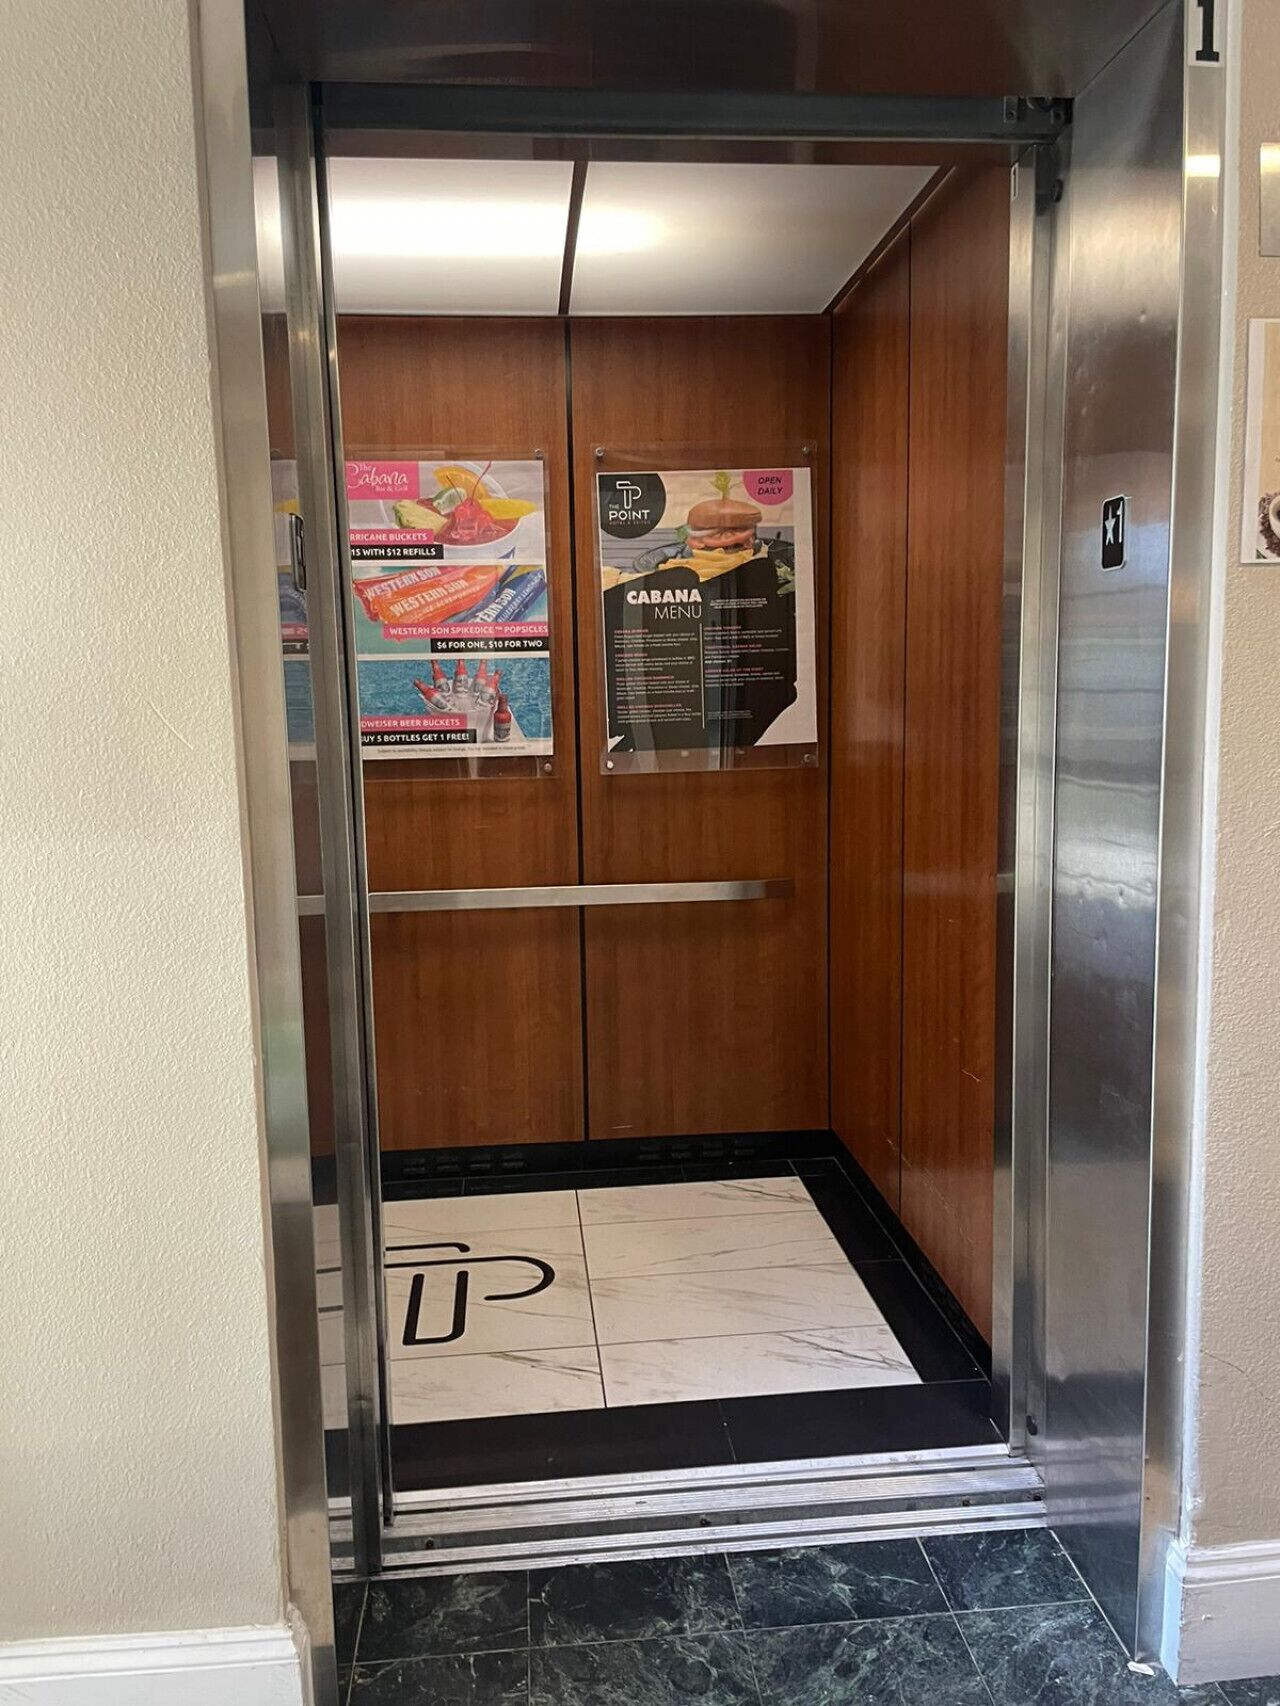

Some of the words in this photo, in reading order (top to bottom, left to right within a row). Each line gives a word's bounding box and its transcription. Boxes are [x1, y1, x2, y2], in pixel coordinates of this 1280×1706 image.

[1196, 0, 1219, 62] 1
[758, 476, 782, 485] OPEN
[757, 487, 783, 495] DAILY
[608, 509, 650, 521] POINT
[388, 532, 428, 541] BUCKETS
[362, 548, 385, 556] WITH
[386, 548, 402, 557] $12
[402, 547, 436, 556] REFILLS
[389, 586, 448, 616] WESTERN
[626, 588, 703, 605] CABANA
[654, 605, 702, 620] MENU
[389, 627, 430, 636] WESTERN
[431, 627, 450, 635] SON
[504, 625, 549, 634] POPSICLES
[436, 641, 447, 649] $6
[448, 641, 466, 649] FOR
[466, 641, 487, 649] ONE,
[488, 640, 503, 648] $10
[504, 640, 522, 648] FOR
[522, 640, 543, 648] TWO
[400, 719, 421, 727] BEER
[383, 734, 420, 742] BOTTLES
[422, 733, 438, 741] GET
[440, 733, 445, 741] 1
[446, 732, 469, 741] FREE!
